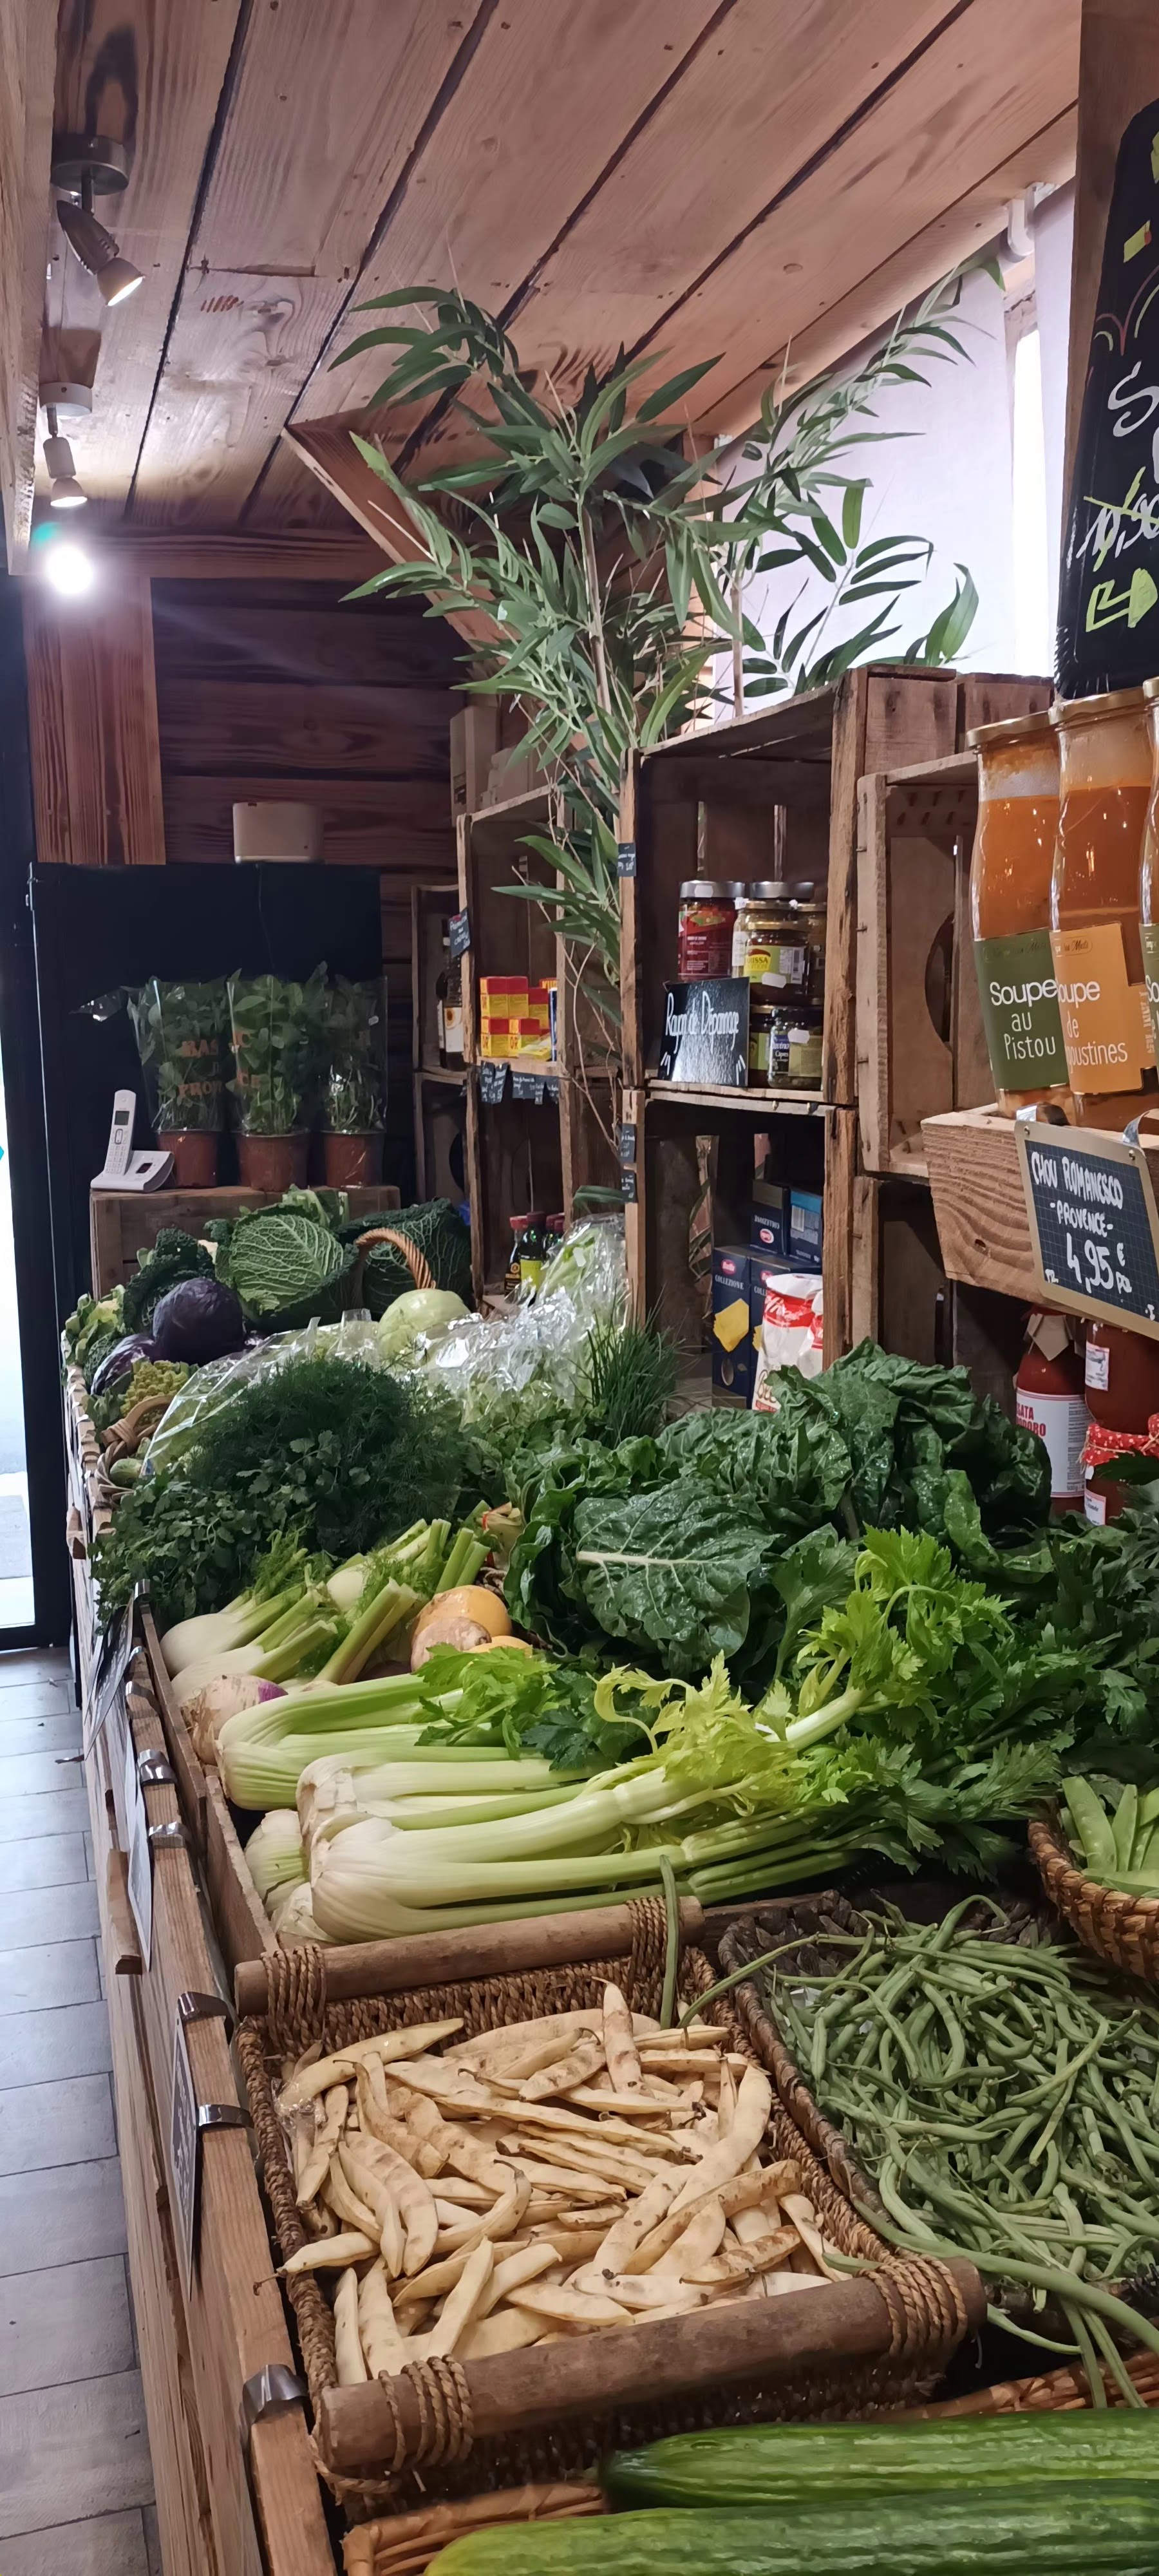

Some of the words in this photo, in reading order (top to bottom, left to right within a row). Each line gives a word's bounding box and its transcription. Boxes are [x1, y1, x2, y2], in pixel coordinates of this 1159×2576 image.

[990, 979, 1058, 1007] Soupe
[1057, 981, 1100, 1009] oupe
[1011, 1011, 1032, 1032] au
[1066, 1010, 1079, 1038] de
[1004, 1033, 1056, 1060] Pistou
[1066, 1041, 1128, 1074] goustines
[1032, 1151, 1057, 1188] CHOU
[1062, 1156, 1124, 1209] ROMANESCO
[1066, 1232, 1114, 1293] 4,95
[714, 1274, 744, 1291] COLLEZIONE
[1017, 1402, 1034, 1421] SATA
